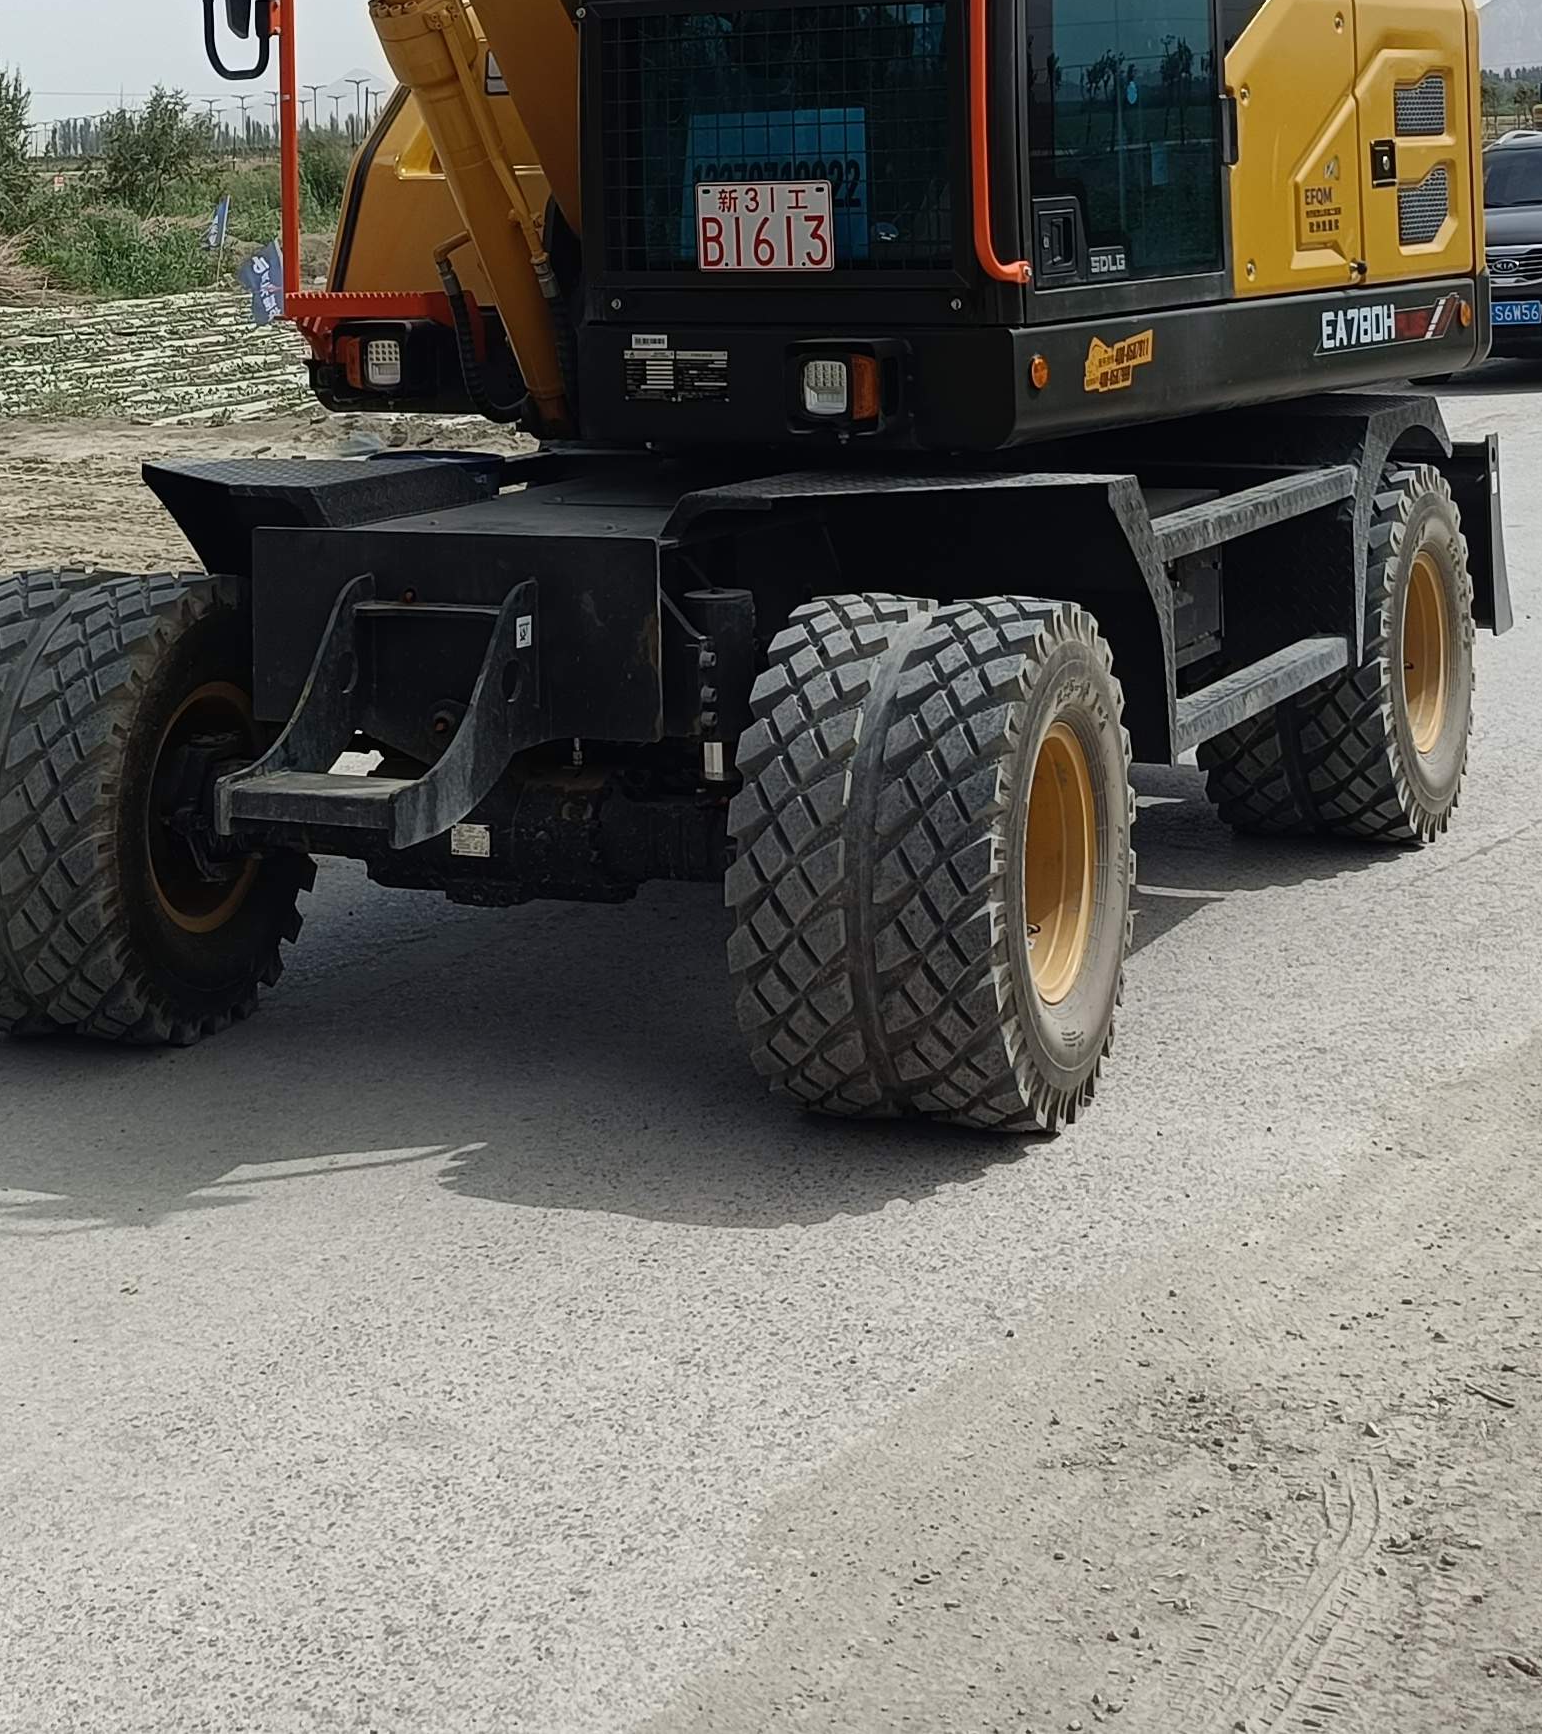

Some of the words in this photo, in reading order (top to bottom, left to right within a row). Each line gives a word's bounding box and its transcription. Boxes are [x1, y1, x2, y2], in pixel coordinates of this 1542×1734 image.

[1304, 186, 1332, 205] EFQM
[701, 214, 828, 267] B1613
[1090, 254, 1125, 273] SDLG
[1496, 262, 1514, 270] KIA
[1321, 304, 1396, 349] EA780H
